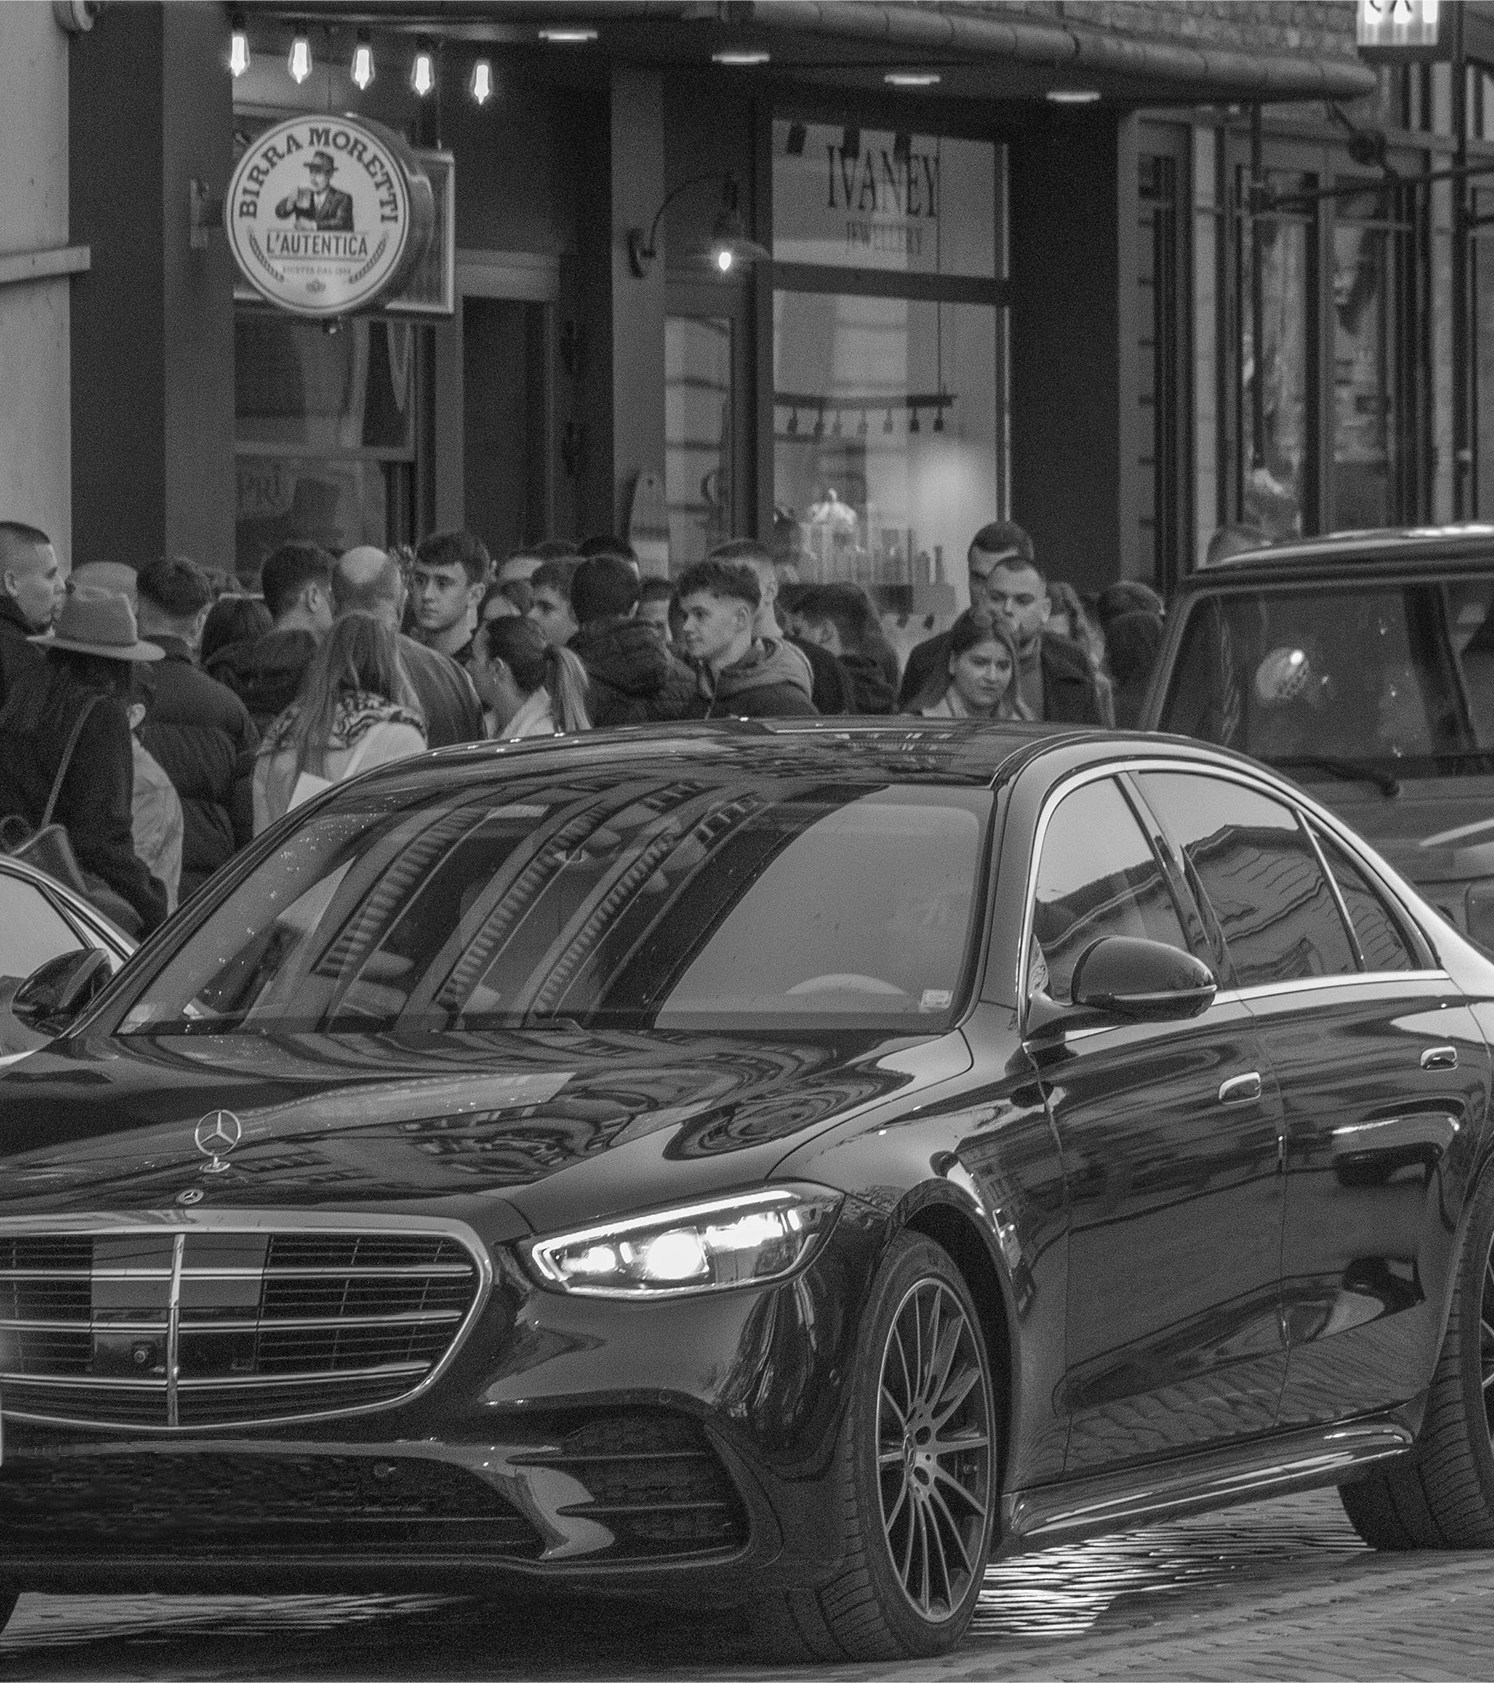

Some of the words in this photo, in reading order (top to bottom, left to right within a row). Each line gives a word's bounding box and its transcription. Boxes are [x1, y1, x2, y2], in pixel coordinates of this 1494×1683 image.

[239, 134, 303, 219] BIRRA
[308, 127, 399, 223] MORETTI
[826, 144, 939, 218] IVANEY
[266, 233, 368, 256] L'AUTENTICA
